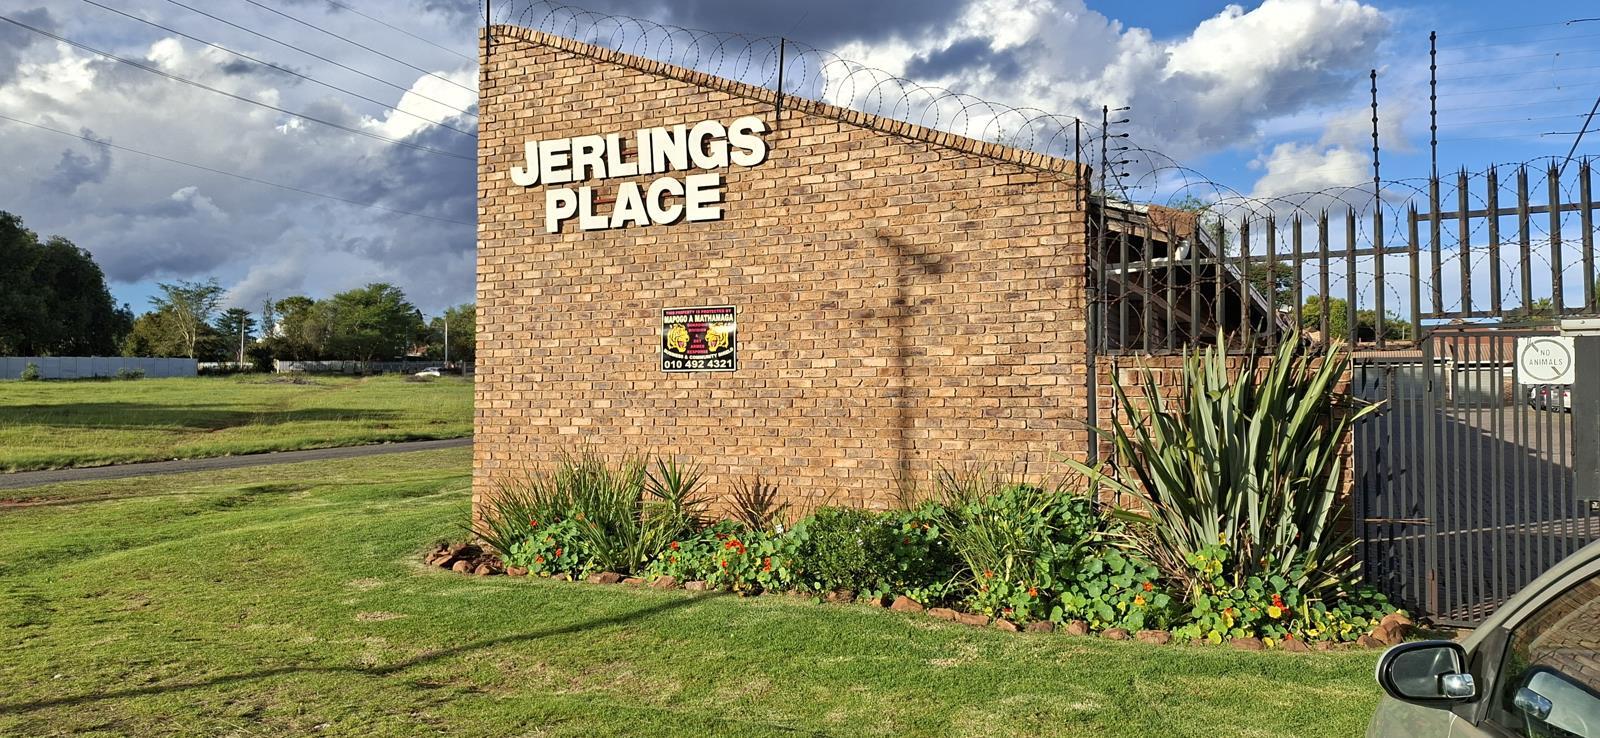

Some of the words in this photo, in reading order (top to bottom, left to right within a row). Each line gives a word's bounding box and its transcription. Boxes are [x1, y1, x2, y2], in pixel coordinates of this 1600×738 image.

[510, 115, 766, 187] JERLINGS
[545, 173, 721, 233] PLACE
[664, 315, 688, 324] MAPOGO
[694, 314, 734, 323] MATHAMAGA
[664, 360, 682, 368] 010
[685, 360, 704, 368] 492
[707, 359, 732, 368] 4321
